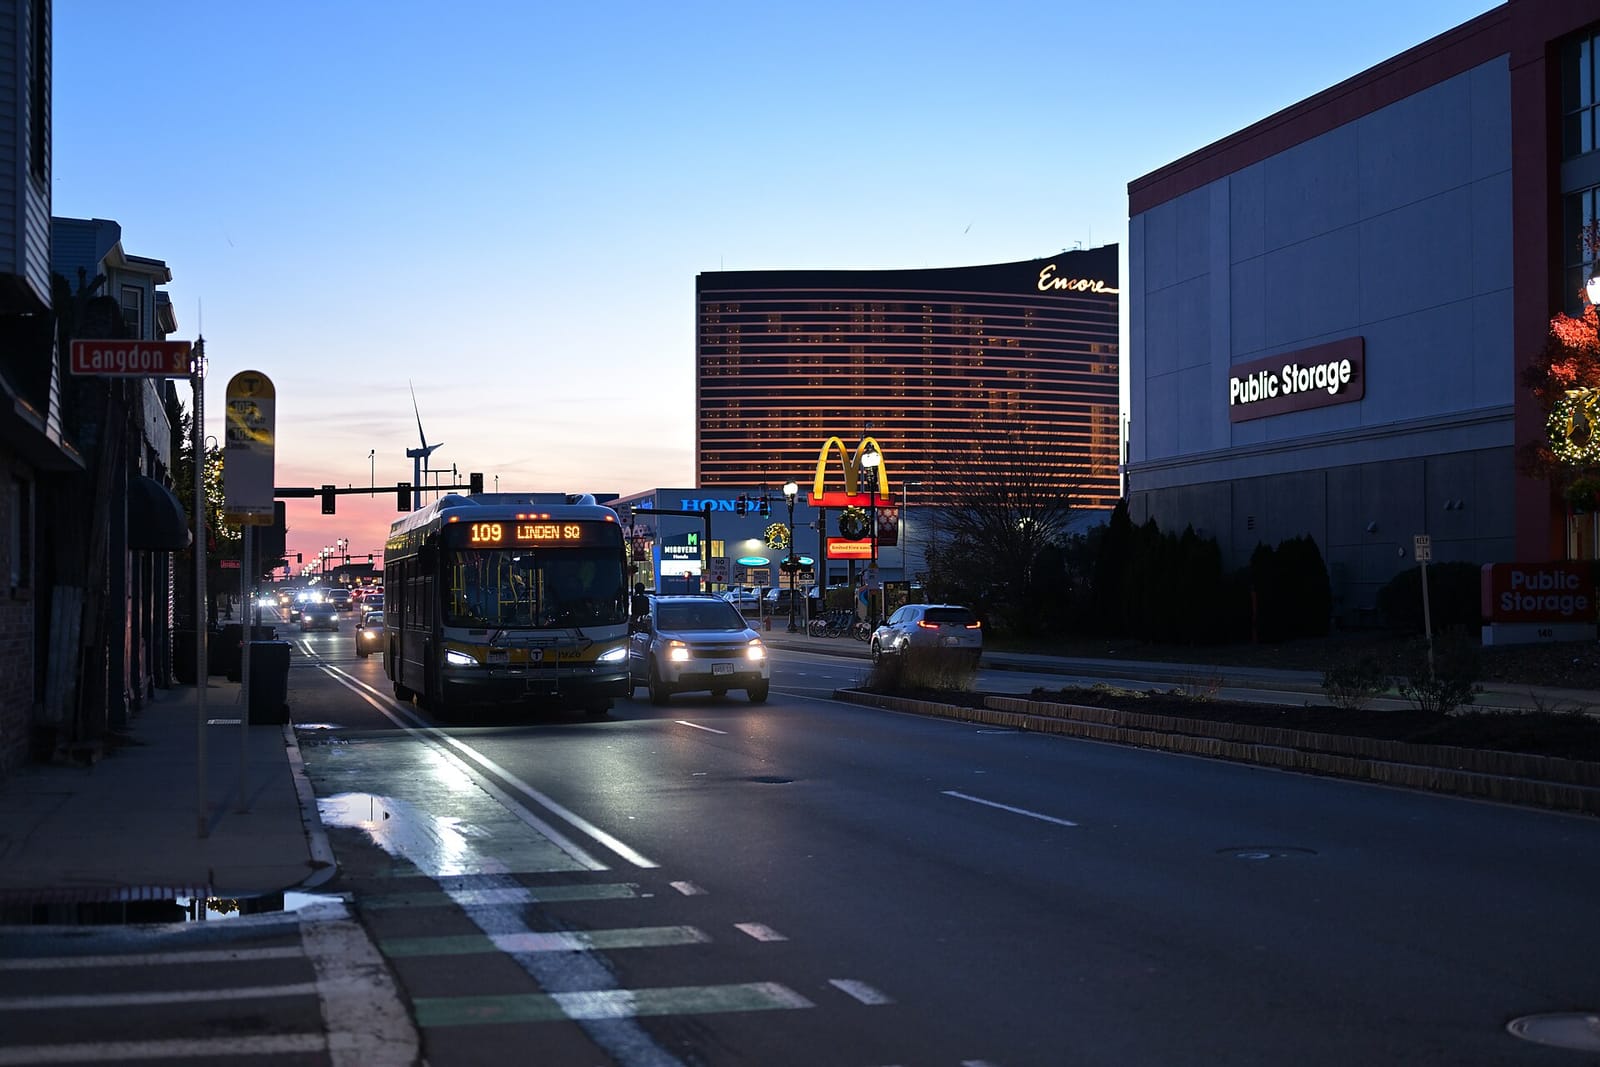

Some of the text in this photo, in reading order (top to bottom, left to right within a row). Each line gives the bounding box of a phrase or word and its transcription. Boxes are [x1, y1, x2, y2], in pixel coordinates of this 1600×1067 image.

[1037, 263, 1119, 293] Encore
[79, 343, 163, 372] Langdon
[1230, 357, 1352, 406] Public Storage
[471, 524, 580, 542] 109 LINDEN SQ
[1511, 570, 1580, 591] Public
[1499, 591, 1588, 616] Storage
